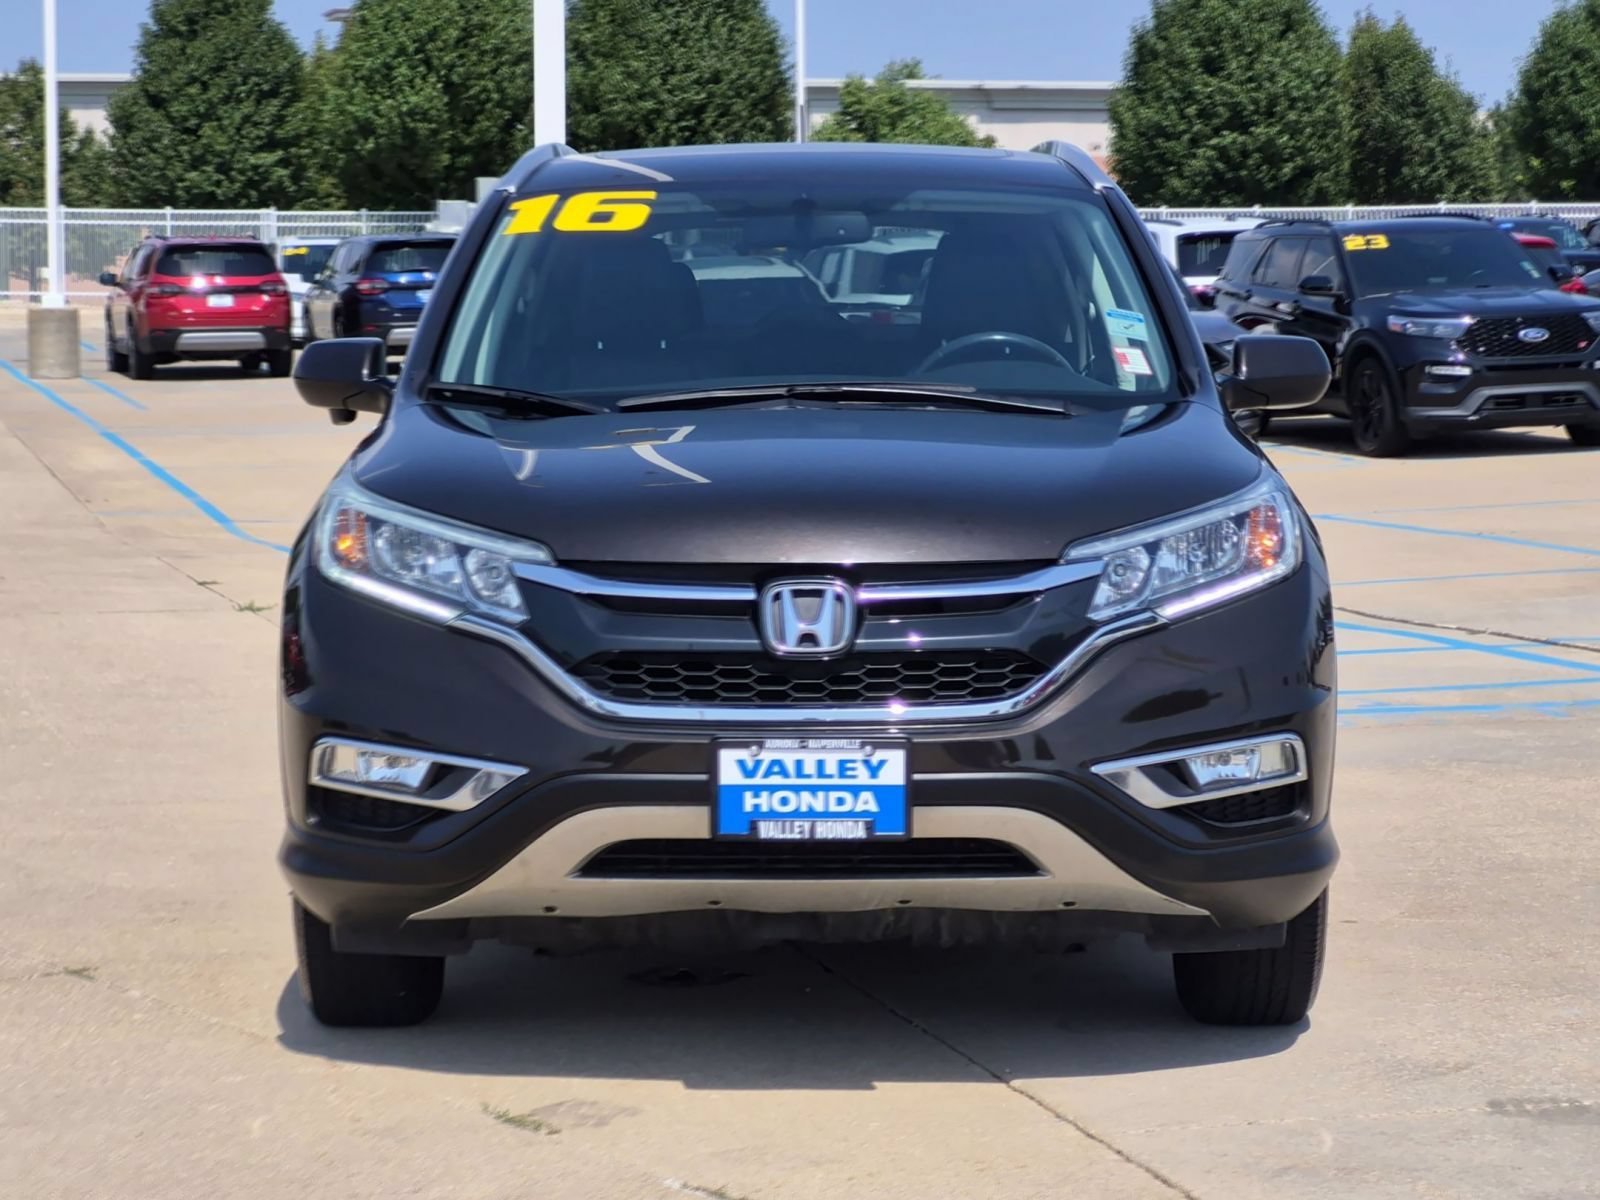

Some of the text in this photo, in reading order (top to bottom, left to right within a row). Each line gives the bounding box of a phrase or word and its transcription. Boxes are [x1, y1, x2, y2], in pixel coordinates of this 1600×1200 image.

[503, 190, 658, 235] 16
[1342, 234, 1390, 250] 23
[735, 758, 888, 779] VALLEY
[743, 790, 880, 813] HONDA
[757, 820, 812, 839] VALLEY
[814, 820, 867, 839] HONDA
